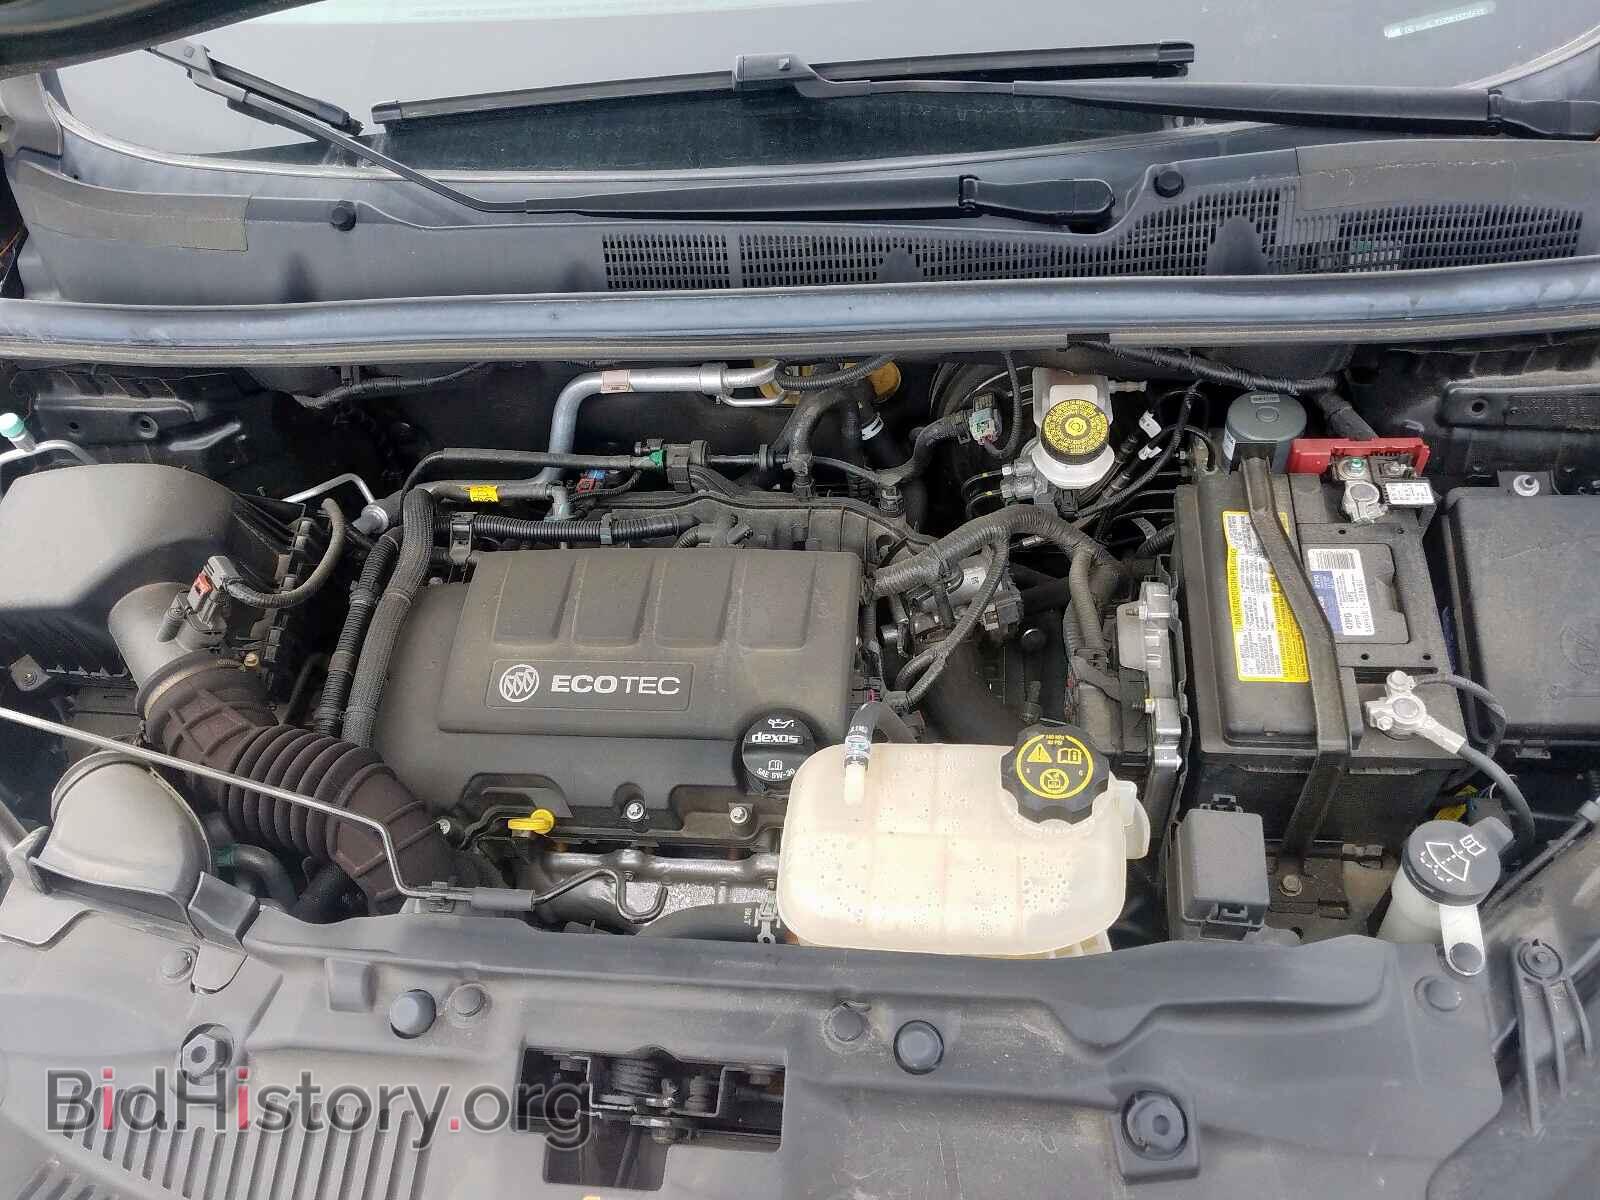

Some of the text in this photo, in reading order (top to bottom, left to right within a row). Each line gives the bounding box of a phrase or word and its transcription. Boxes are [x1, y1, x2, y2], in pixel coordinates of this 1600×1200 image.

[551, 674, 680, 695] ECOTEC
[751, 732, 801, 744] dexos
[756, 767, 770, 778] SAE
